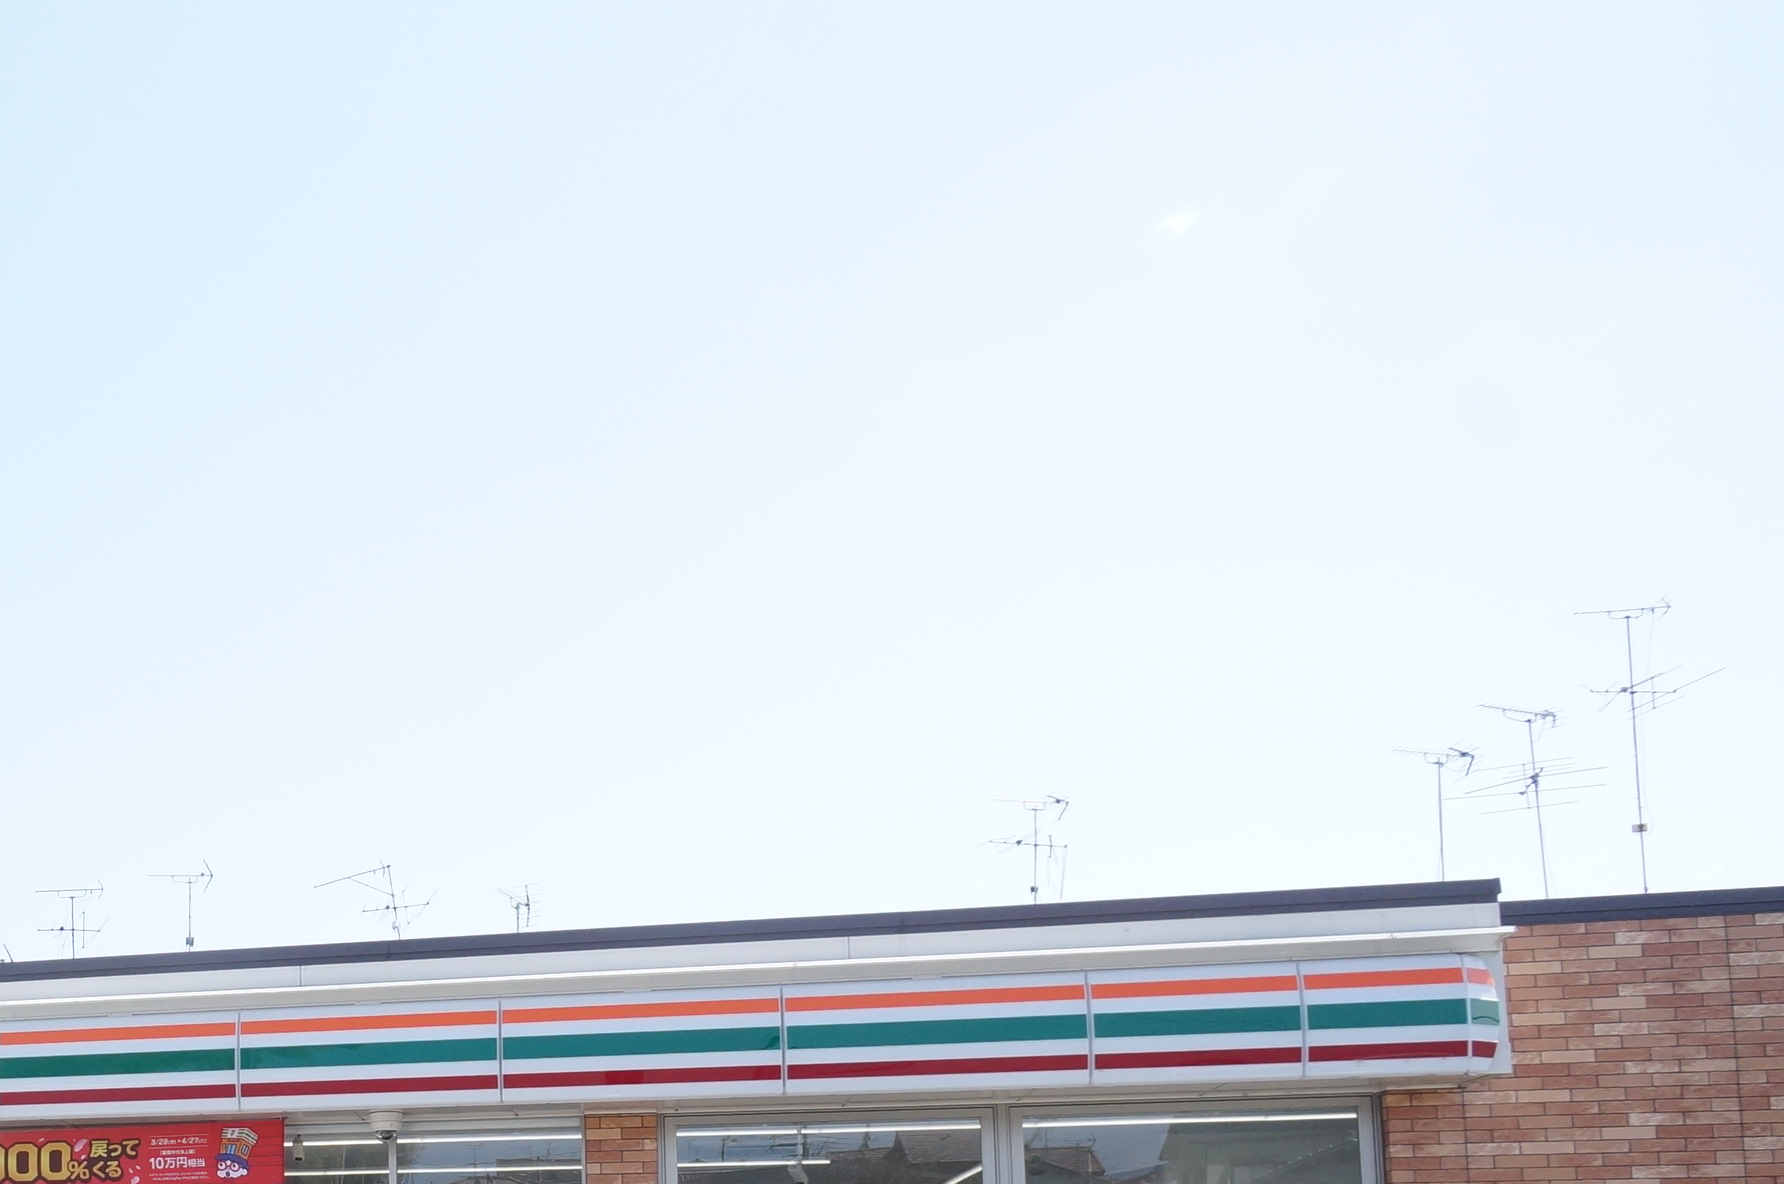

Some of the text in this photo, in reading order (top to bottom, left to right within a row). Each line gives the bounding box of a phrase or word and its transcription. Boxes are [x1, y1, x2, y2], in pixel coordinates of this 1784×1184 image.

[90, 1139, 140, 1158] 戻って
[92, 1160, 122, 1178] くる
[149, 1156, 206, 1170] 10万円相当
